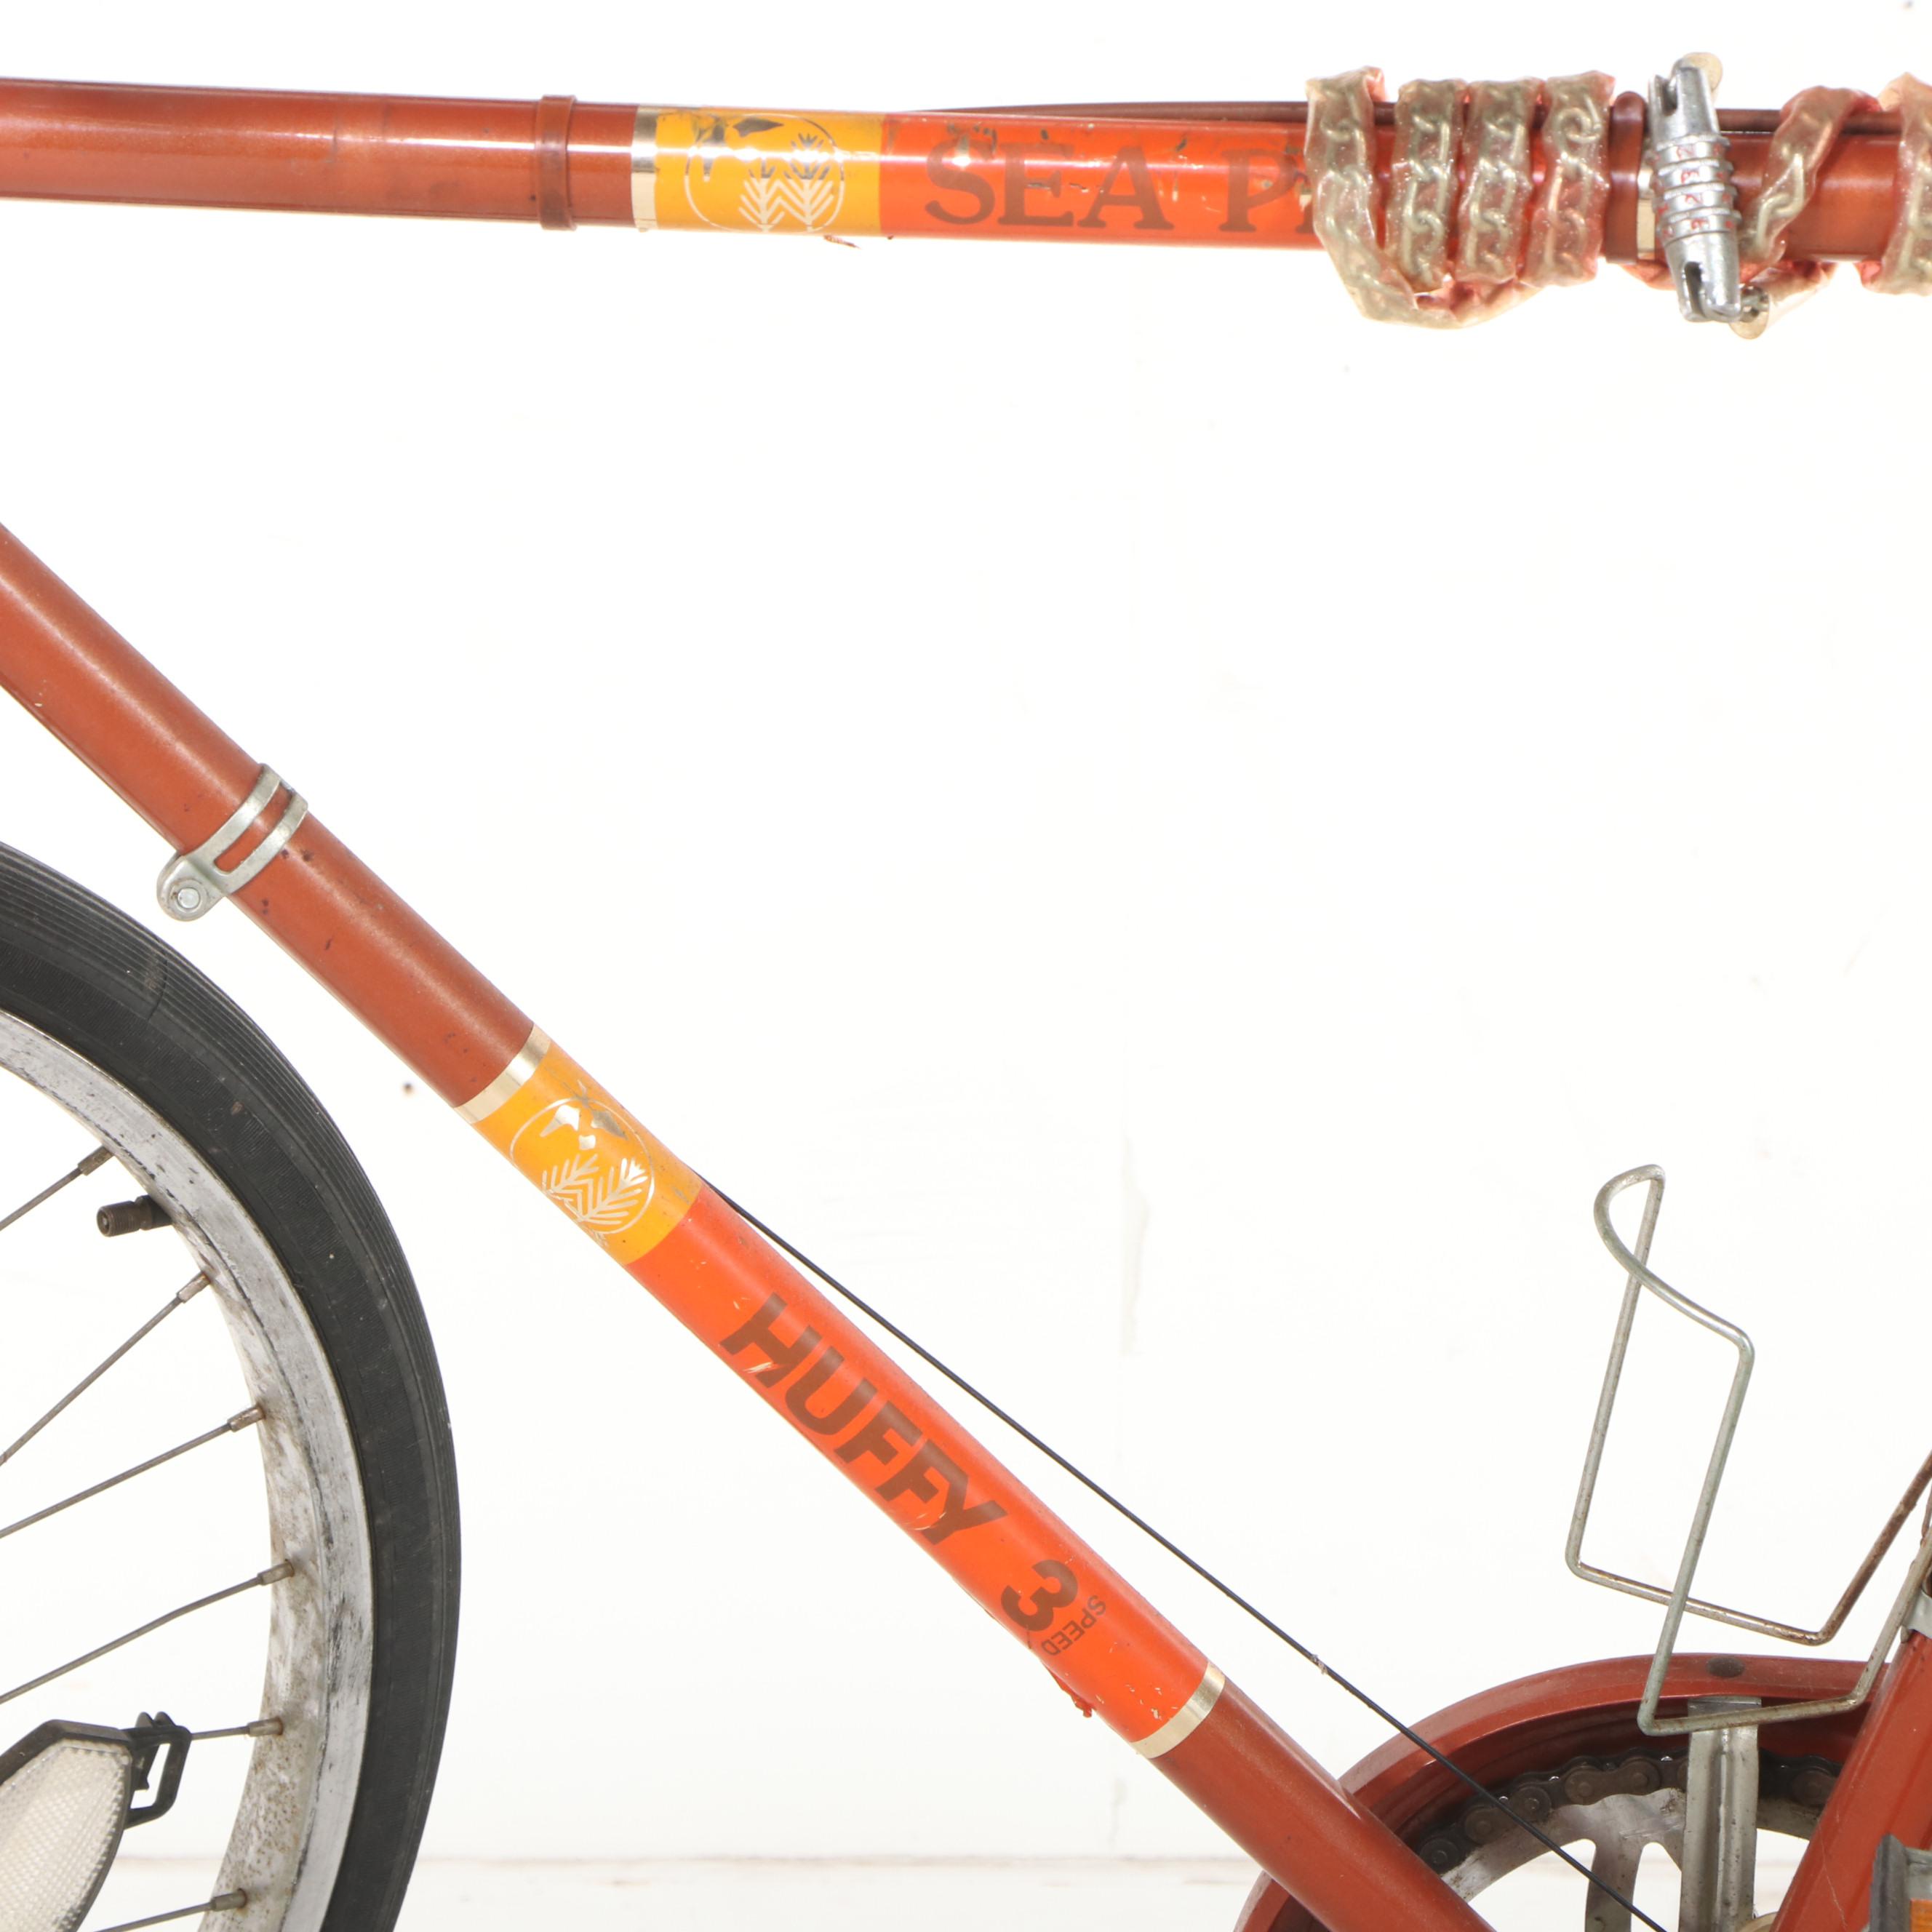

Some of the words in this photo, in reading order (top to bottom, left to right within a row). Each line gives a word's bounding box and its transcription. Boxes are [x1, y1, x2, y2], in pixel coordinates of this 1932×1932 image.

[925, 140, 1175, 230] SEA
[719, 1292, 1008, 1546] HUFFY
[1001, 1560, 1078, 1632] 3
[1041, 1595, 1106, 1656] SPEED
